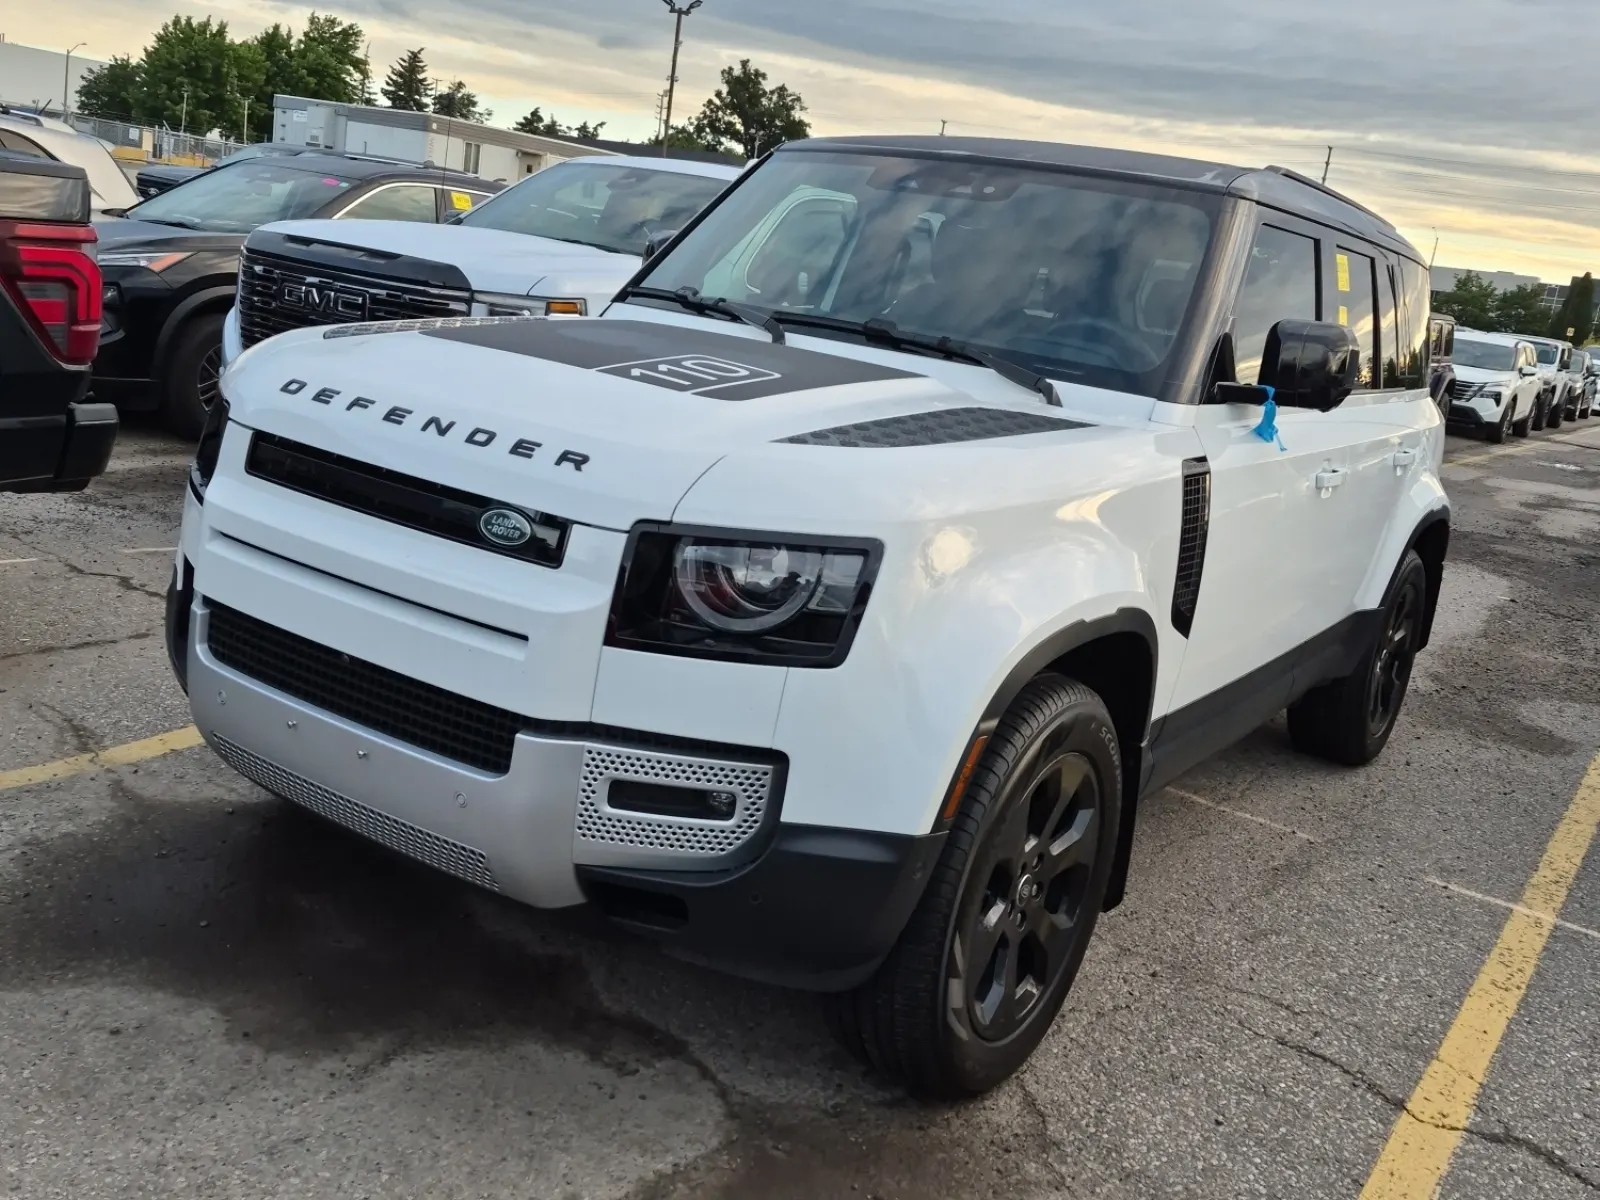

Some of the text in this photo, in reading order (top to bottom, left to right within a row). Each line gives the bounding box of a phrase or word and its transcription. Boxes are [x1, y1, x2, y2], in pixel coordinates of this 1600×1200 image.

[278, 283, 363, 318] GMC
[630, 360, 750, 386] 110
[279, 378, 591, 472] DEFENDER
